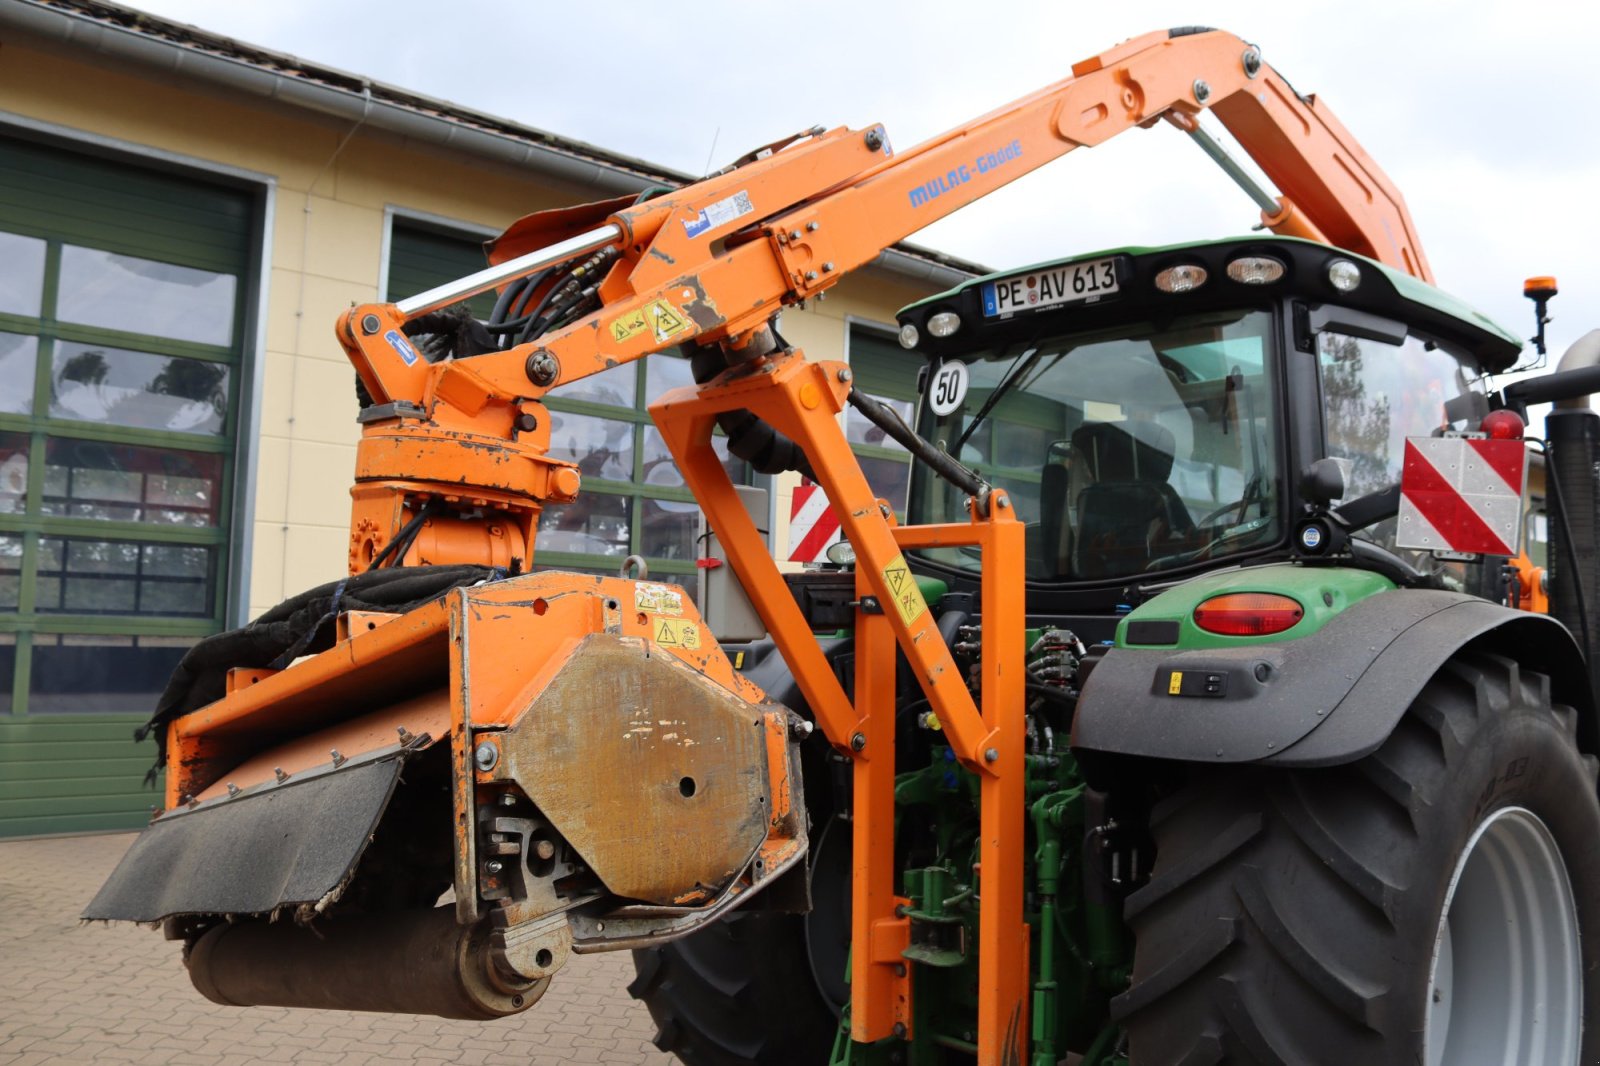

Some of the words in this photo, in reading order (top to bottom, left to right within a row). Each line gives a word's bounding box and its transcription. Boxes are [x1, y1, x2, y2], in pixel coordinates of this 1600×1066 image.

[997, 279, 1025, 309] PE
[1040, 271, 1066, 300] AV
[1072, 261, 1115, 294] 613
[936, 370, 960, 406] 50
